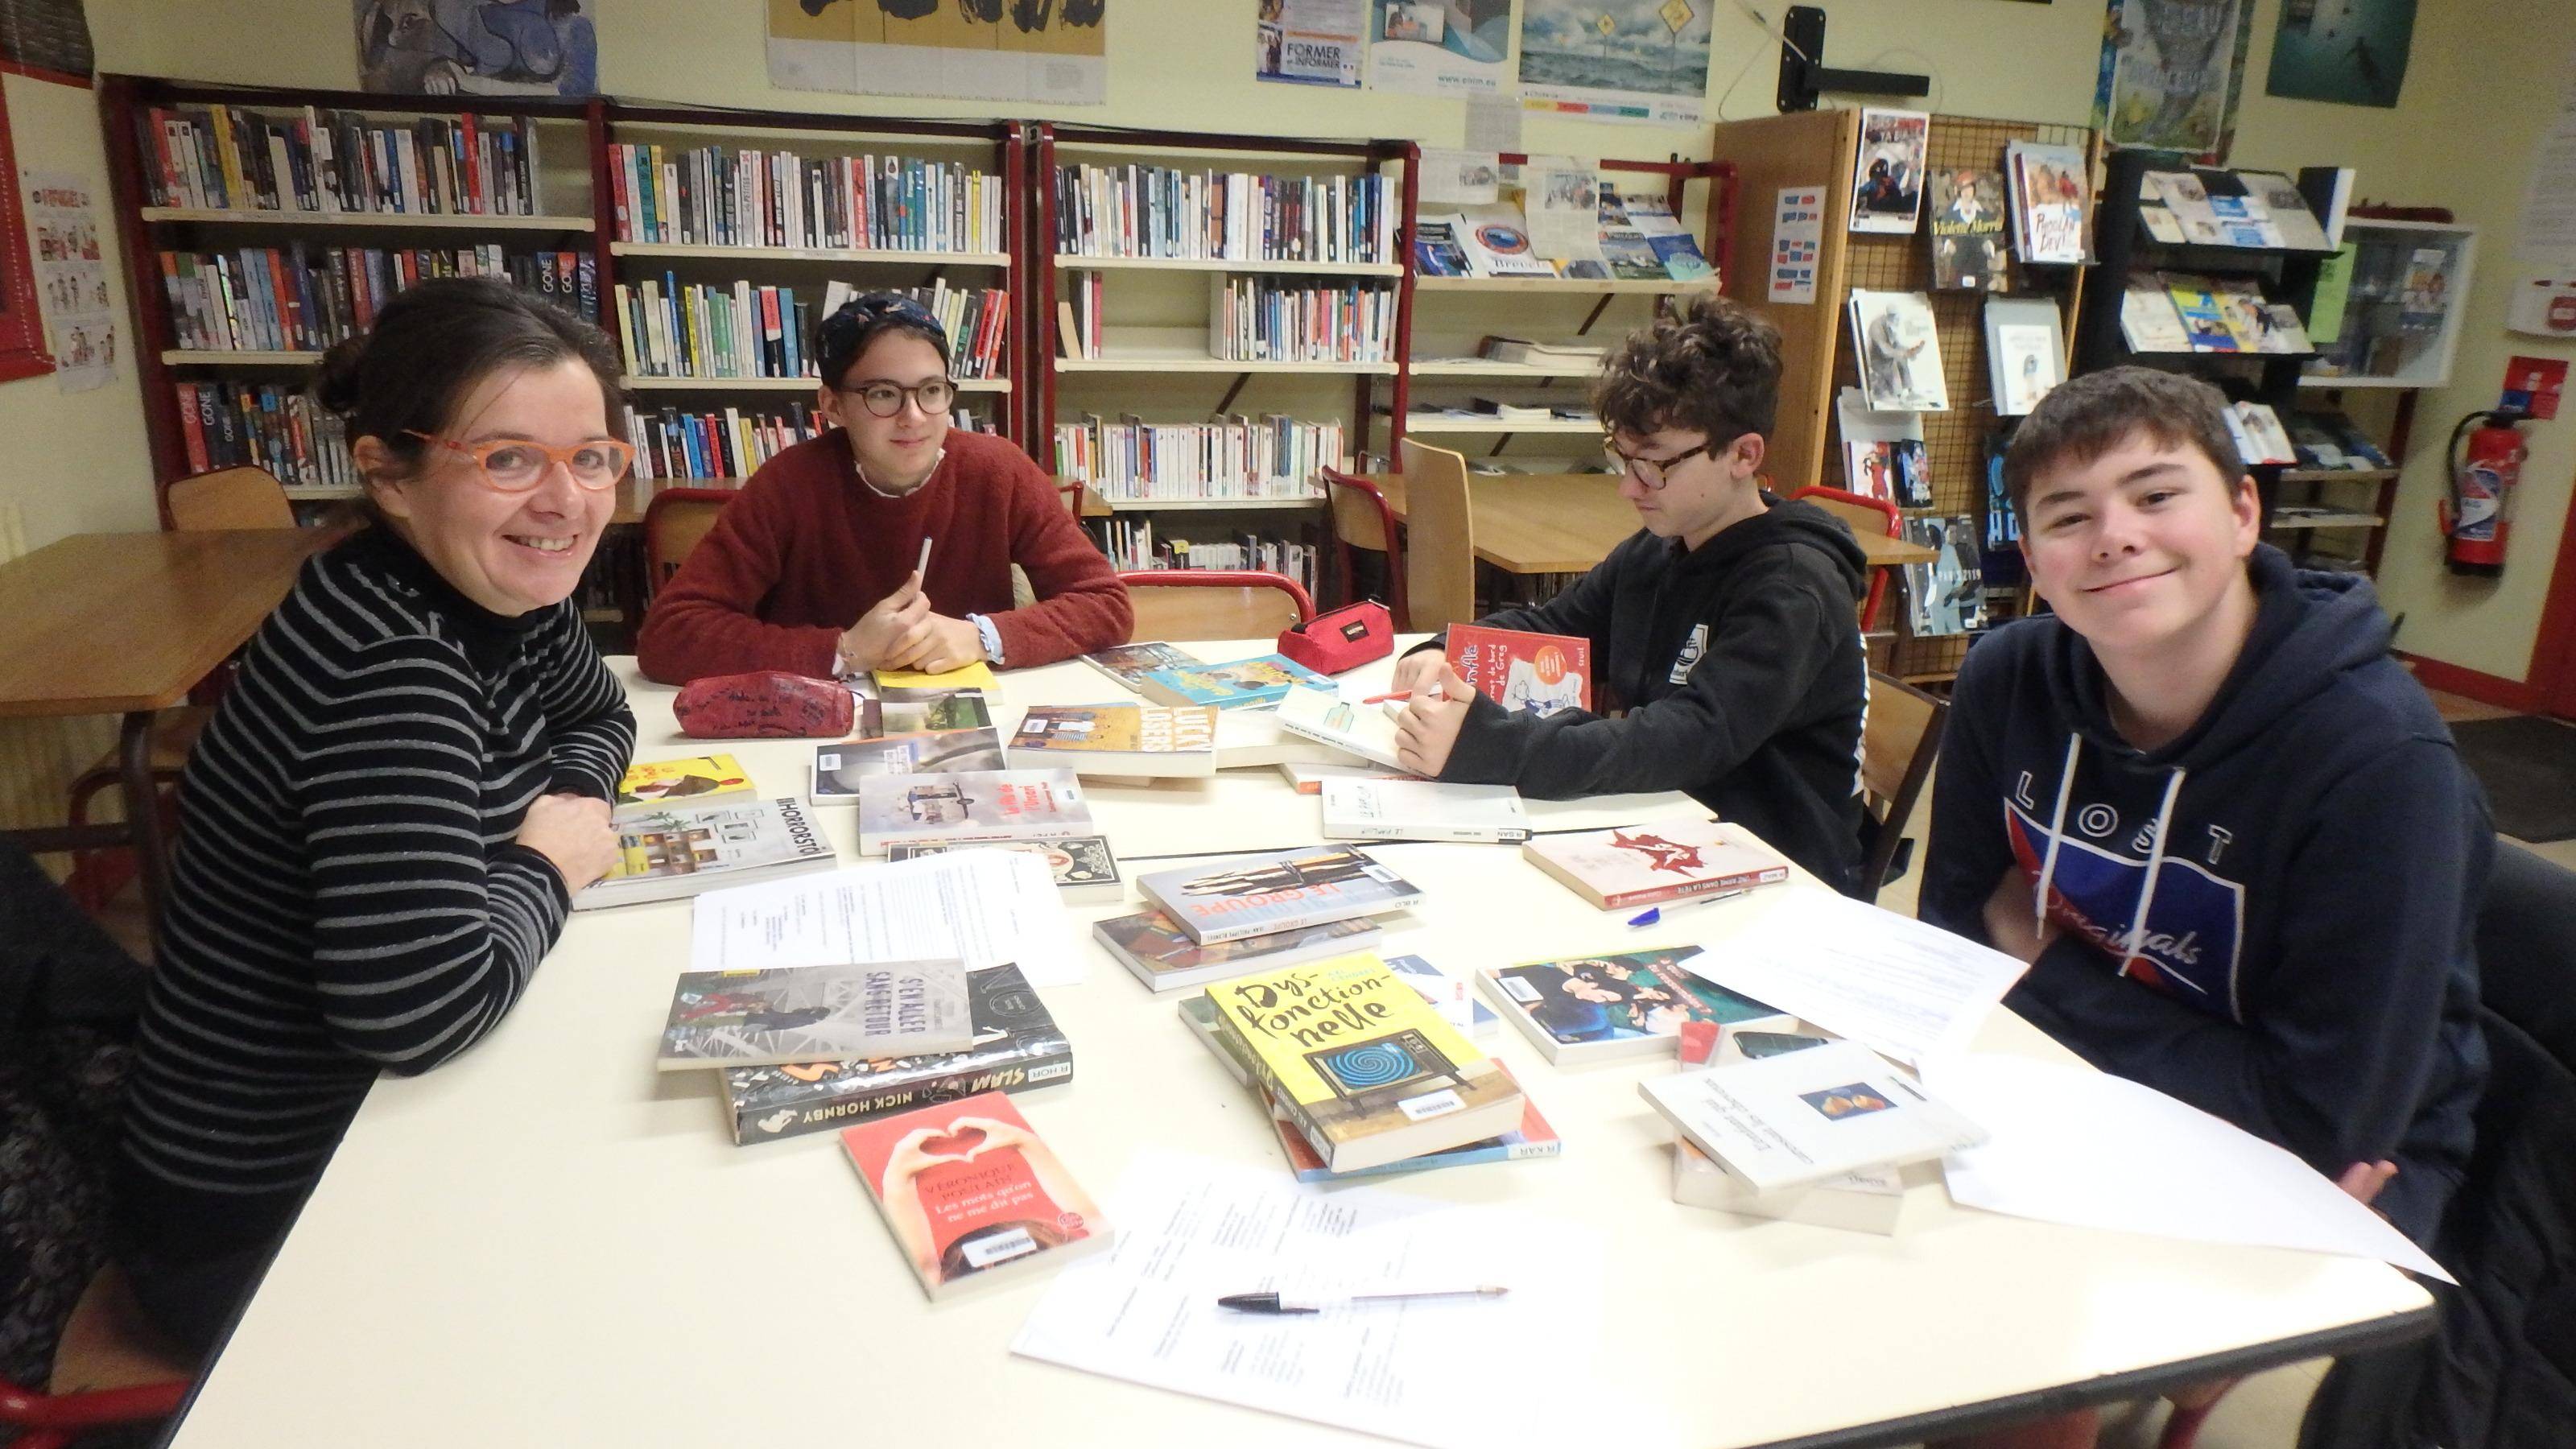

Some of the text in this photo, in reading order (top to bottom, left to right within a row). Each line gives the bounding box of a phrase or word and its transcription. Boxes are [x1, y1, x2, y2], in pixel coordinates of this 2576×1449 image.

[1287, 43, 1340, 60] FORMER
[1294, 56, 1340, 69] INFORMER
[541, 259, 554, 293] GONE
[180, 390, 197, 424] GONE
[199, 390, 216, 427] GONE
[221, 416, 234, 443] GONE
[1488, 644, 1496, 663] bord
[1495, 644, 1508, 687] de Greg
[1140, 706, 1173, 752] LOSERS
[1172, 706, 1212, 752] LUCKY
[2015, 770, 2233, 865] LOST
[1191, 881, 1343, 918] LE GROUPE
[1694, 884, 1703, 893] LA
[1703, 881, 1719, 891] DANS
[1274, 918, 1307, 931] LE GROUPE
[865, 971, 892, 1036] SANS RETOUR
[1234, 972, 1319, 1009] Dys-
[1236, 974, 1390, 1040] fonction-
[898, 1002, 927, 1034] ALLER
[1289, 1001, 1395, 1048] nelle
[971, 1067, 1026, 1093] SLAM
[1030, 1066, 1057, 1079] HOR
[803, 1091, 913, 1125] NICK HORNBY
[1518, 1146, 1544, 1156] KAR
[935, 1180, 1032, 1215] Les mots qu'on
[947, 1192, 1034, 1223] ne me dit pas
